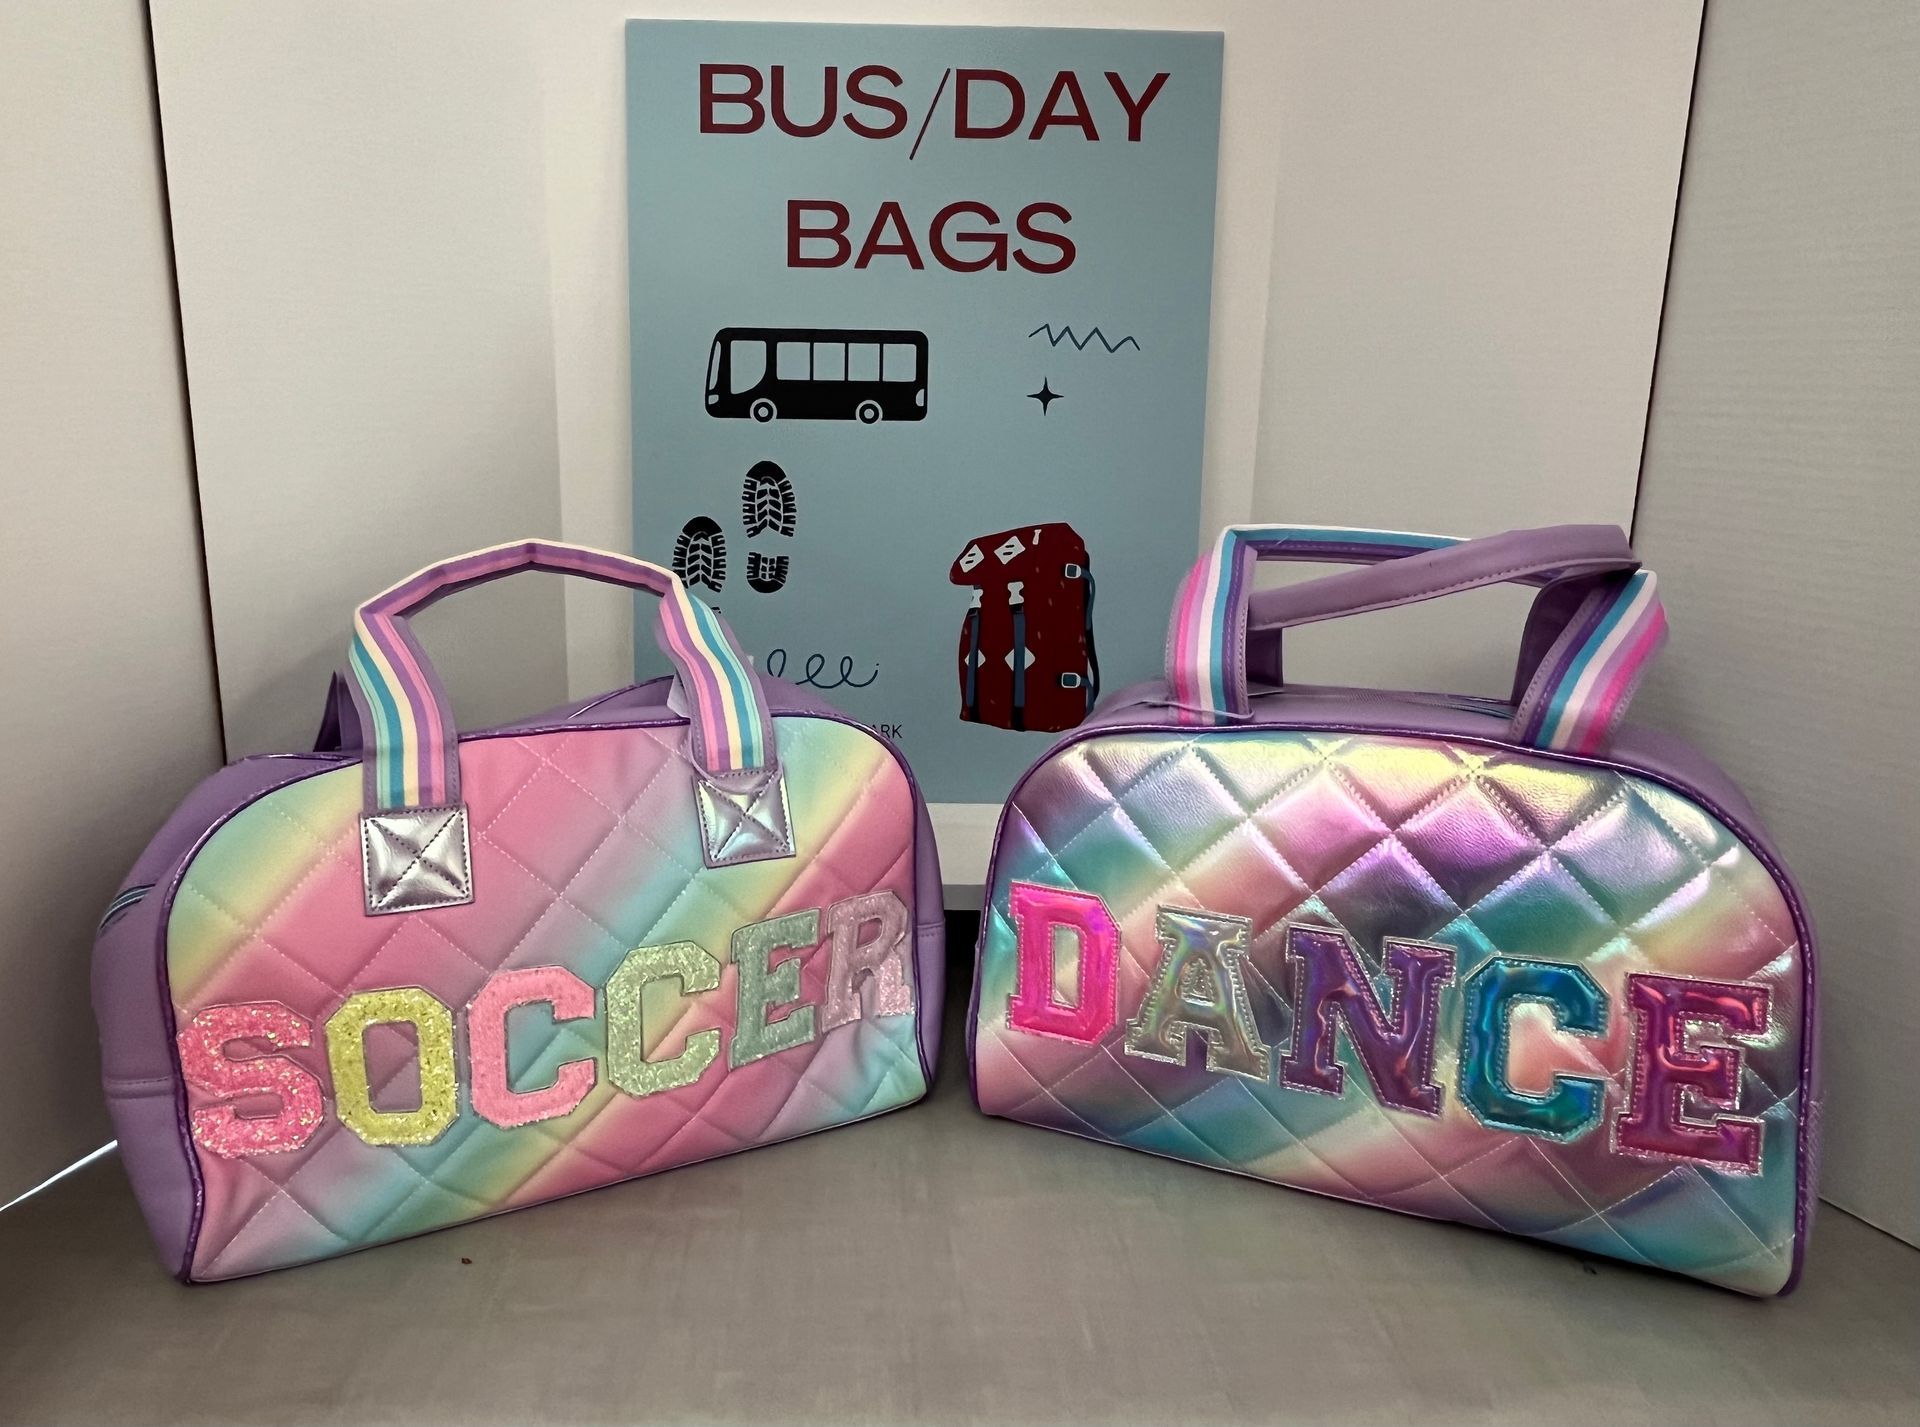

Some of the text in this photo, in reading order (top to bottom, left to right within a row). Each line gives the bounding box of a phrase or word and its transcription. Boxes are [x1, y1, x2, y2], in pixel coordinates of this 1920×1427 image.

[699, 63, 1171, 161] BUS/DAY
[786, 199, 1077, 274] BAGS
[175, 889, 916, 1158] SOCCER
[1005, 879, 1774, 1177] DANCE
